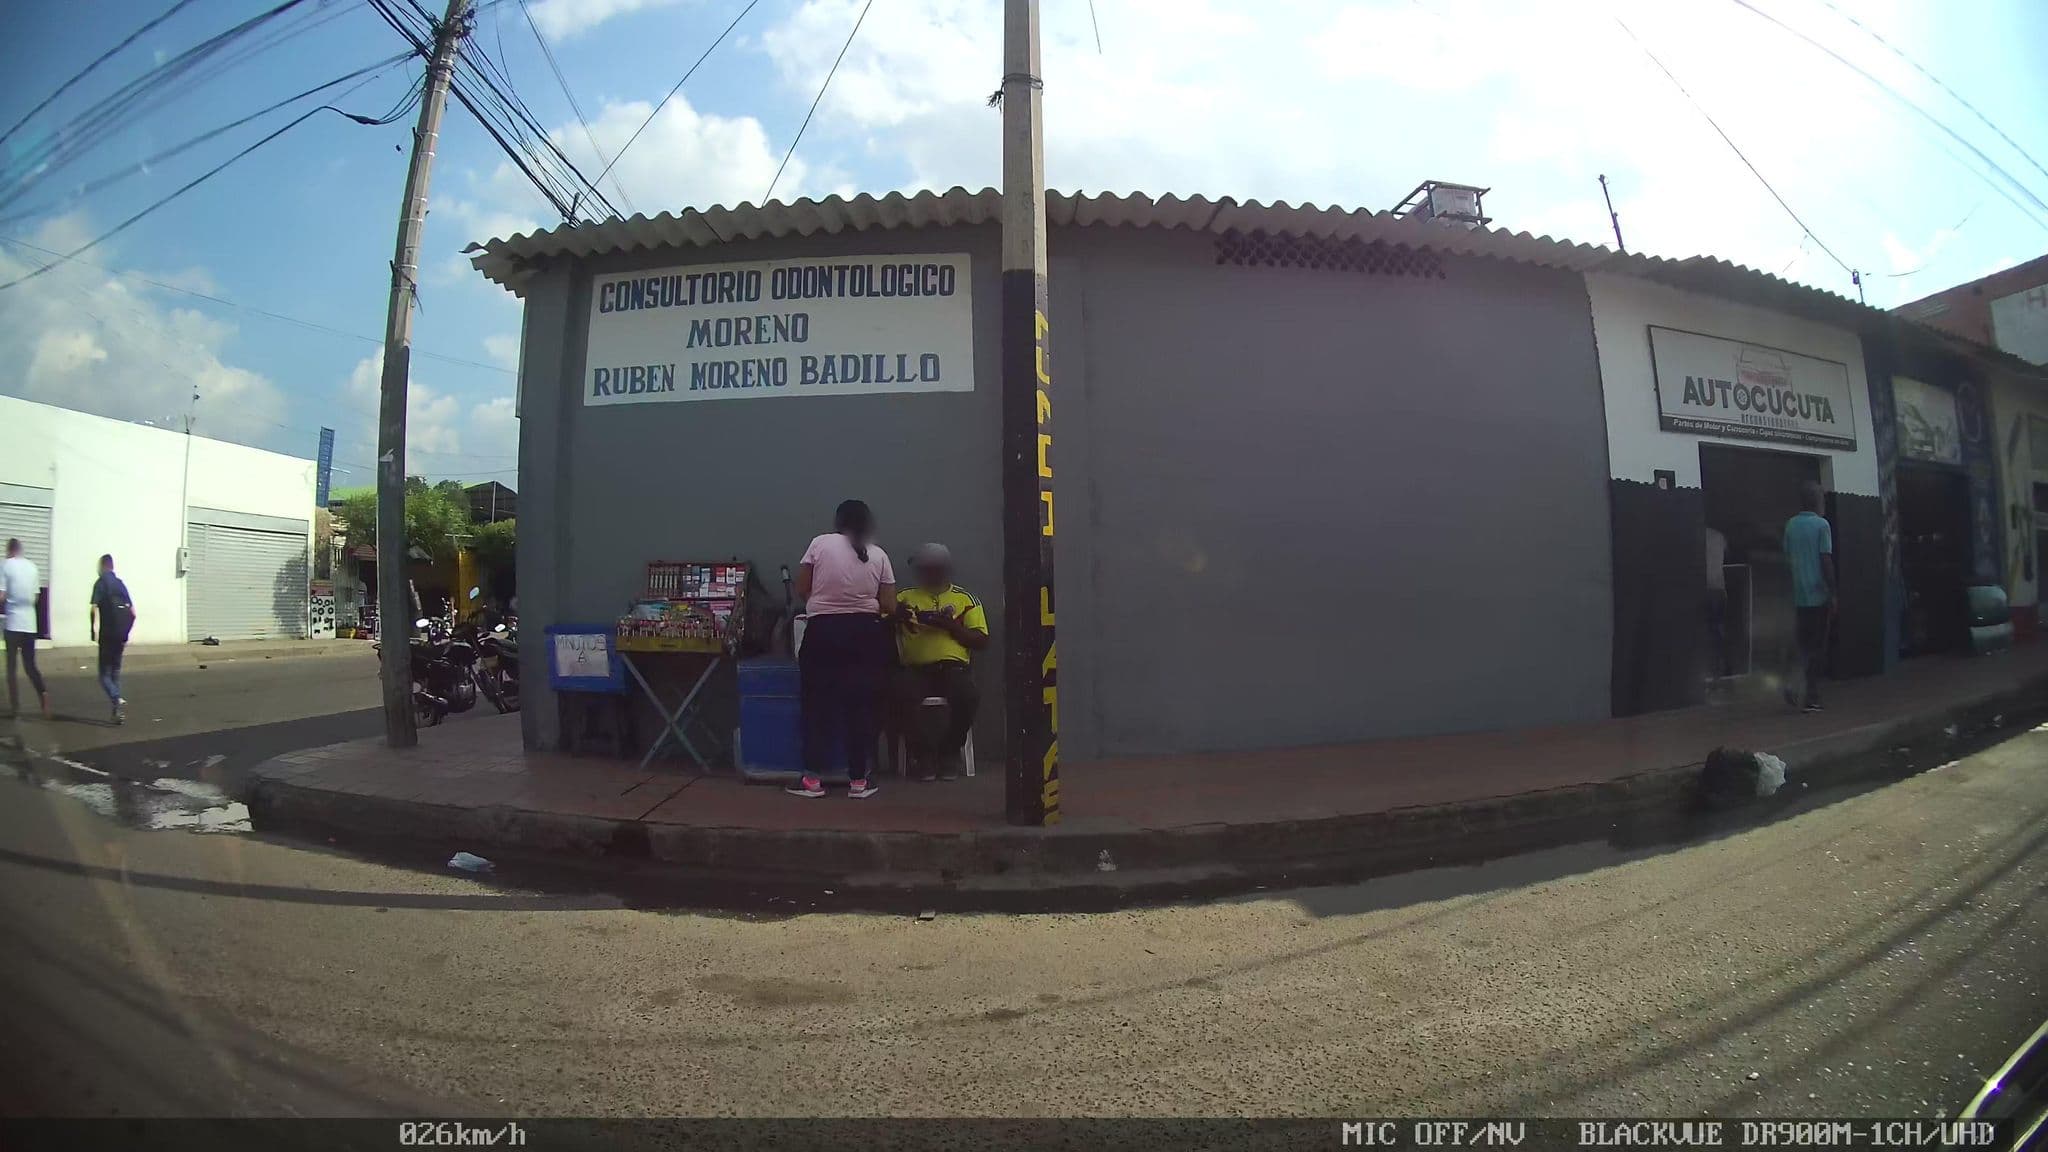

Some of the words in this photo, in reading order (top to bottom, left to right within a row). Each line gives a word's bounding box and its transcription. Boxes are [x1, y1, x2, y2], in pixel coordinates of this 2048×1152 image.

[599, 269, 762, 314] CONSULTORIO
[771, 263, 955, 301] ODONTOLOGICO
[686, 312, 809, 349] MORENO
[593, 364, 676, 397] RUBEN
[689, 356, 788, 391] MORENO
[800, 352, 941, 385] BADILLO
